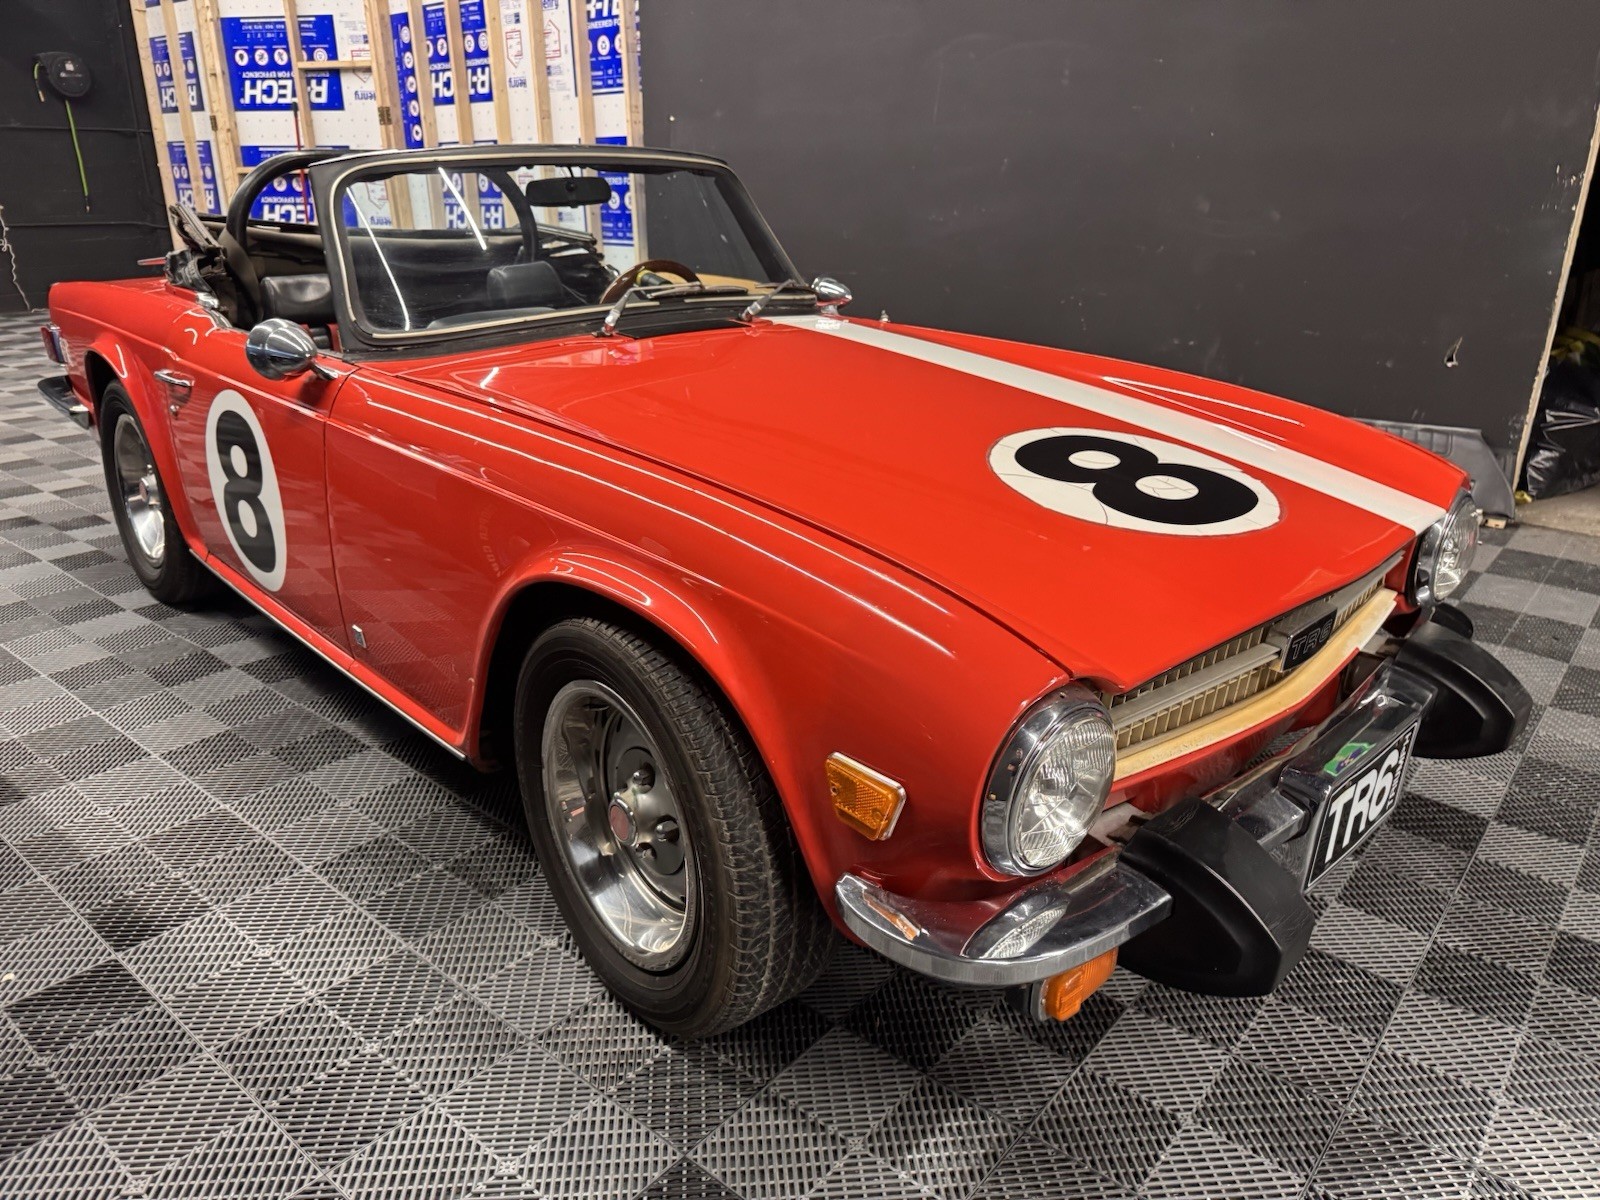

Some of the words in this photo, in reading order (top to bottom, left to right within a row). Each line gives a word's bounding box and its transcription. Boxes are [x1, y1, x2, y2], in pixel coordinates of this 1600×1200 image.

[216, 410, 277, 573] 8
[1014, 435, 1259, 525] 8
[1291, 618, 1334, 661] TR6
[1325, 748, 1400, 864] TR6
